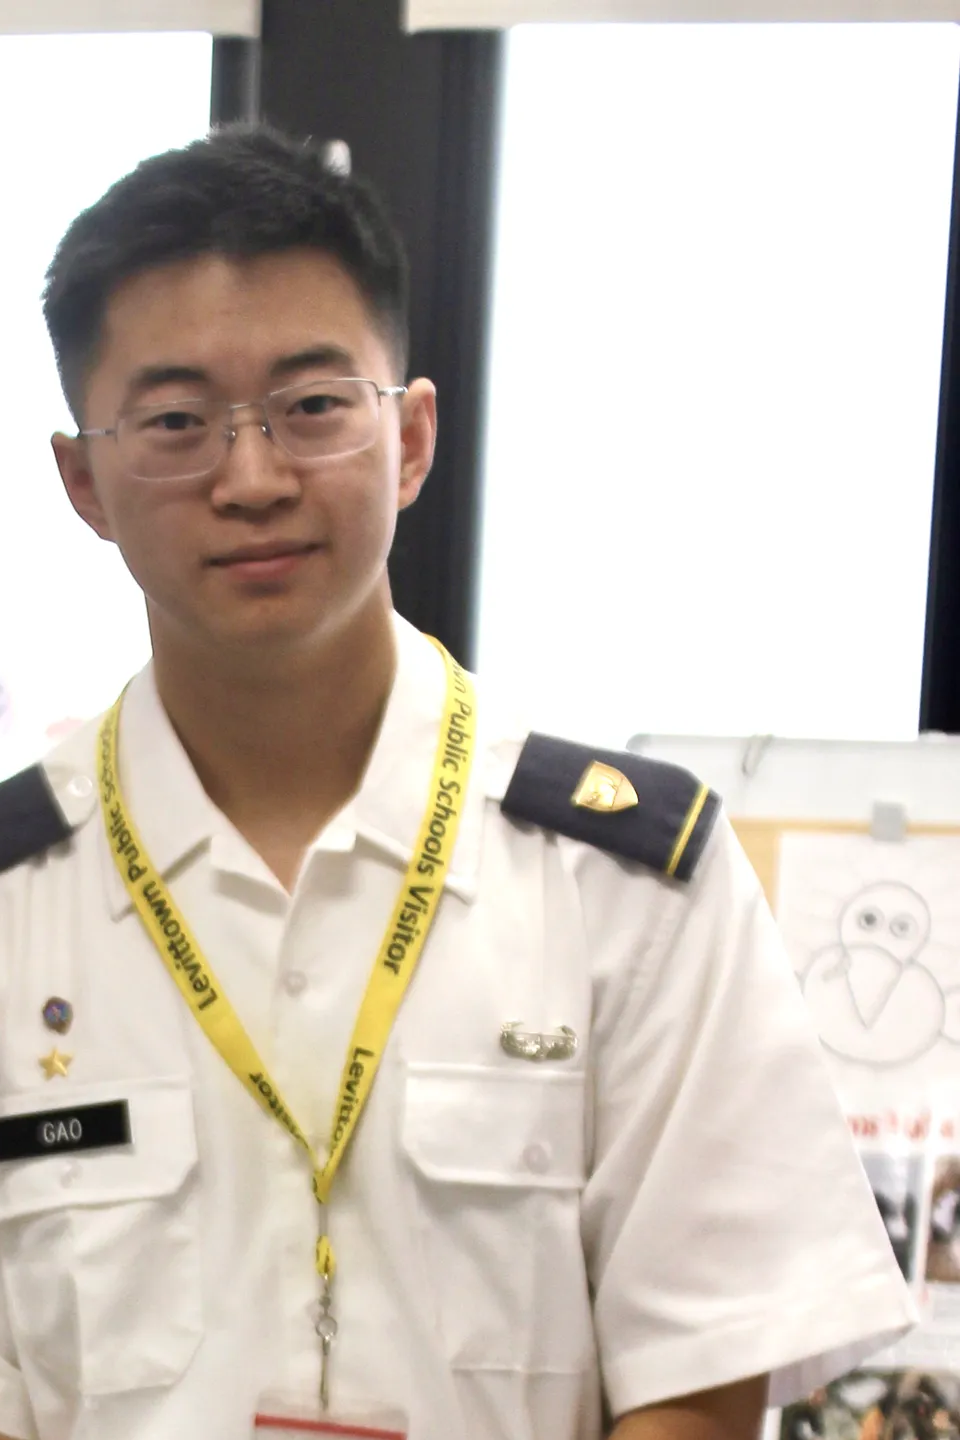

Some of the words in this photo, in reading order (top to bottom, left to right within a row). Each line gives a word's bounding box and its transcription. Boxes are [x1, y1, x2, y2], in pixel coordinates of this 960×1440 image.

[442, 697, 472, 773] Public
[110, 801, 148, 883] Public
[417, 777, 461, 876] Schools
[143, 881, 218, 1010] Levittown
[384, 886, 435, 976] Visitor
[43, 1118, 82, 1143] GAO
[330, 1047, 375, 1155] Levitto
